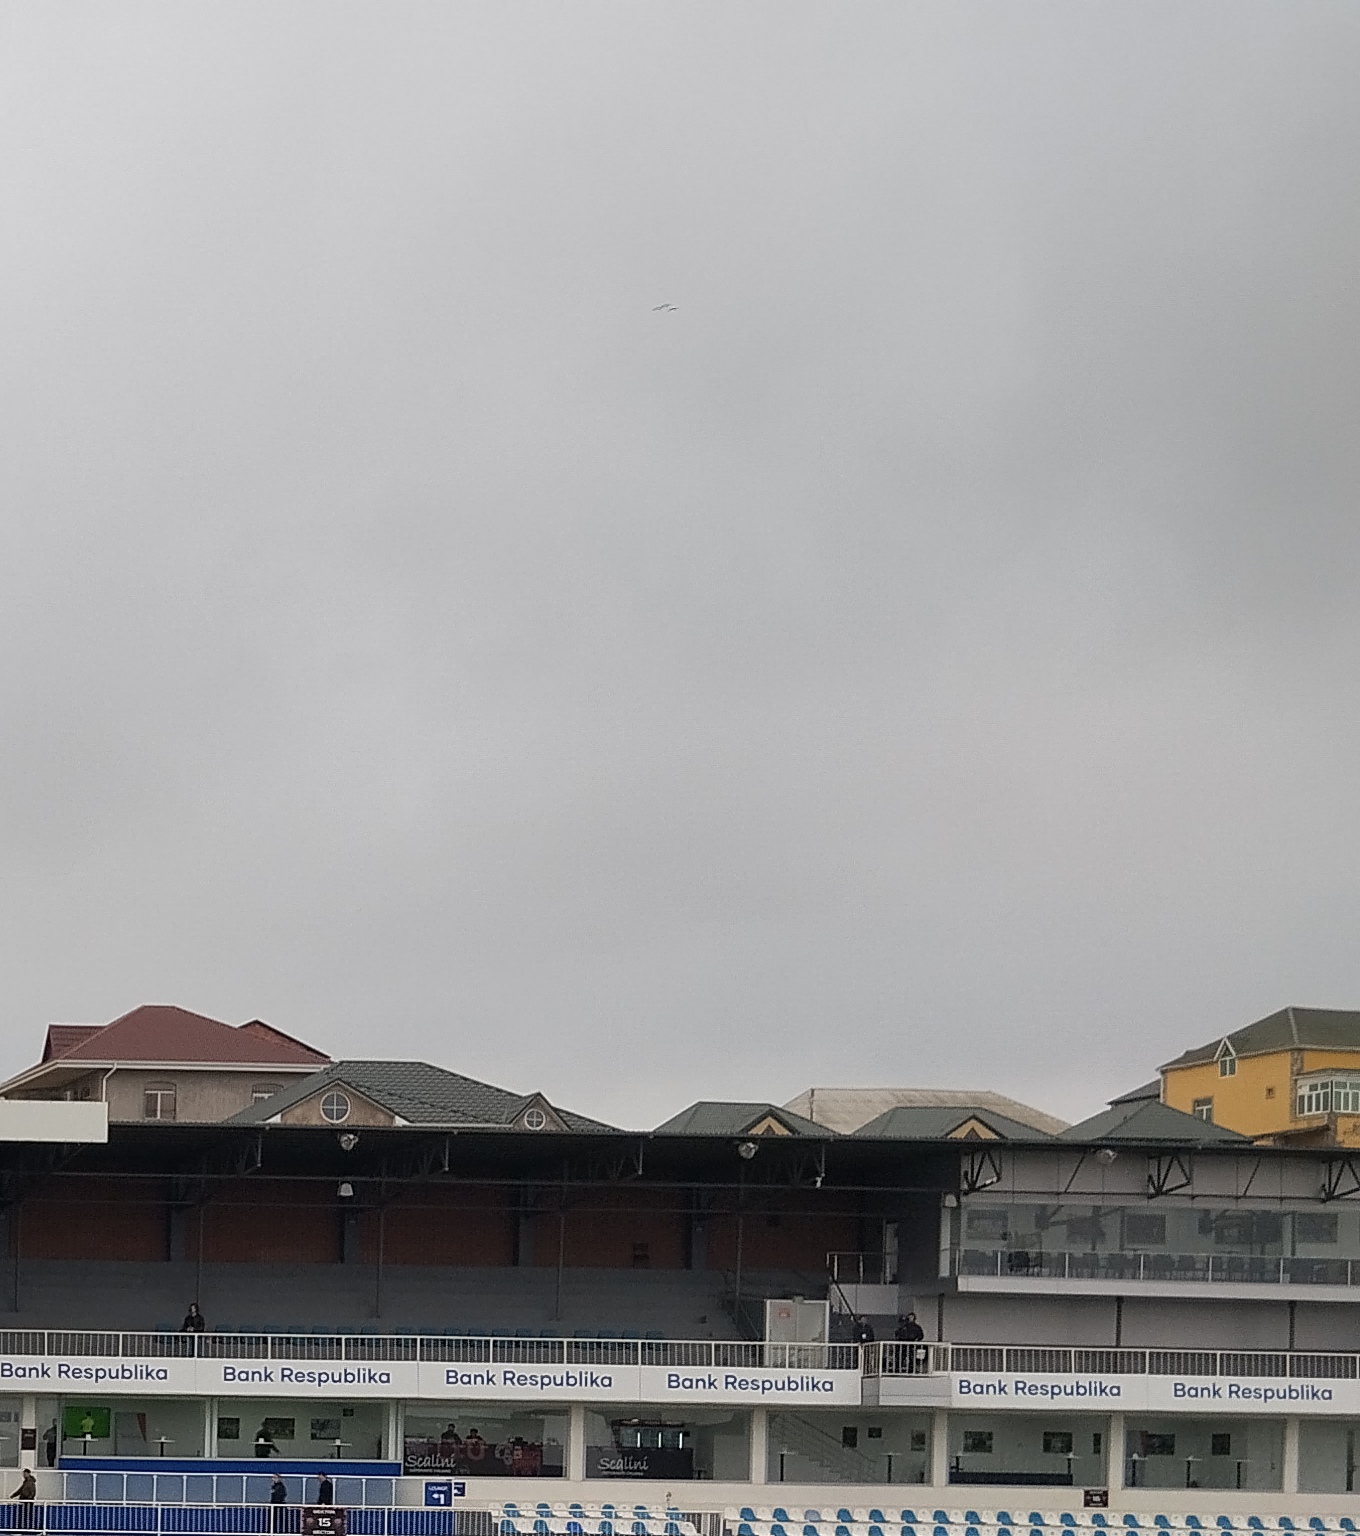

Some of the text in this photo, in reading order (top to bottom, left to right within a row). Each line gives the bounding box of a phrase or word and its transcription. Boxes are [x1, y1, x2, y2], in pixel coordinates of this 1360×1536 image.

[0, 1362, 168, 1384] Bank Respublika
[223, 1365, 391, 1388] Bank Respublika
[445, 1369, 613, 1392] Bank Respublika
[667, 1373, 834, 1396] Bank Respublika
[958, 1378, 1121, 1401] Bank Respublika
[1173, 1382, 1333, 1404] Bank Respublika
[404, 1453, 457, 1468] Scalini
[597, 1455, 649, 1471] Scalini
[317, 1517, 332, 1527] 15
